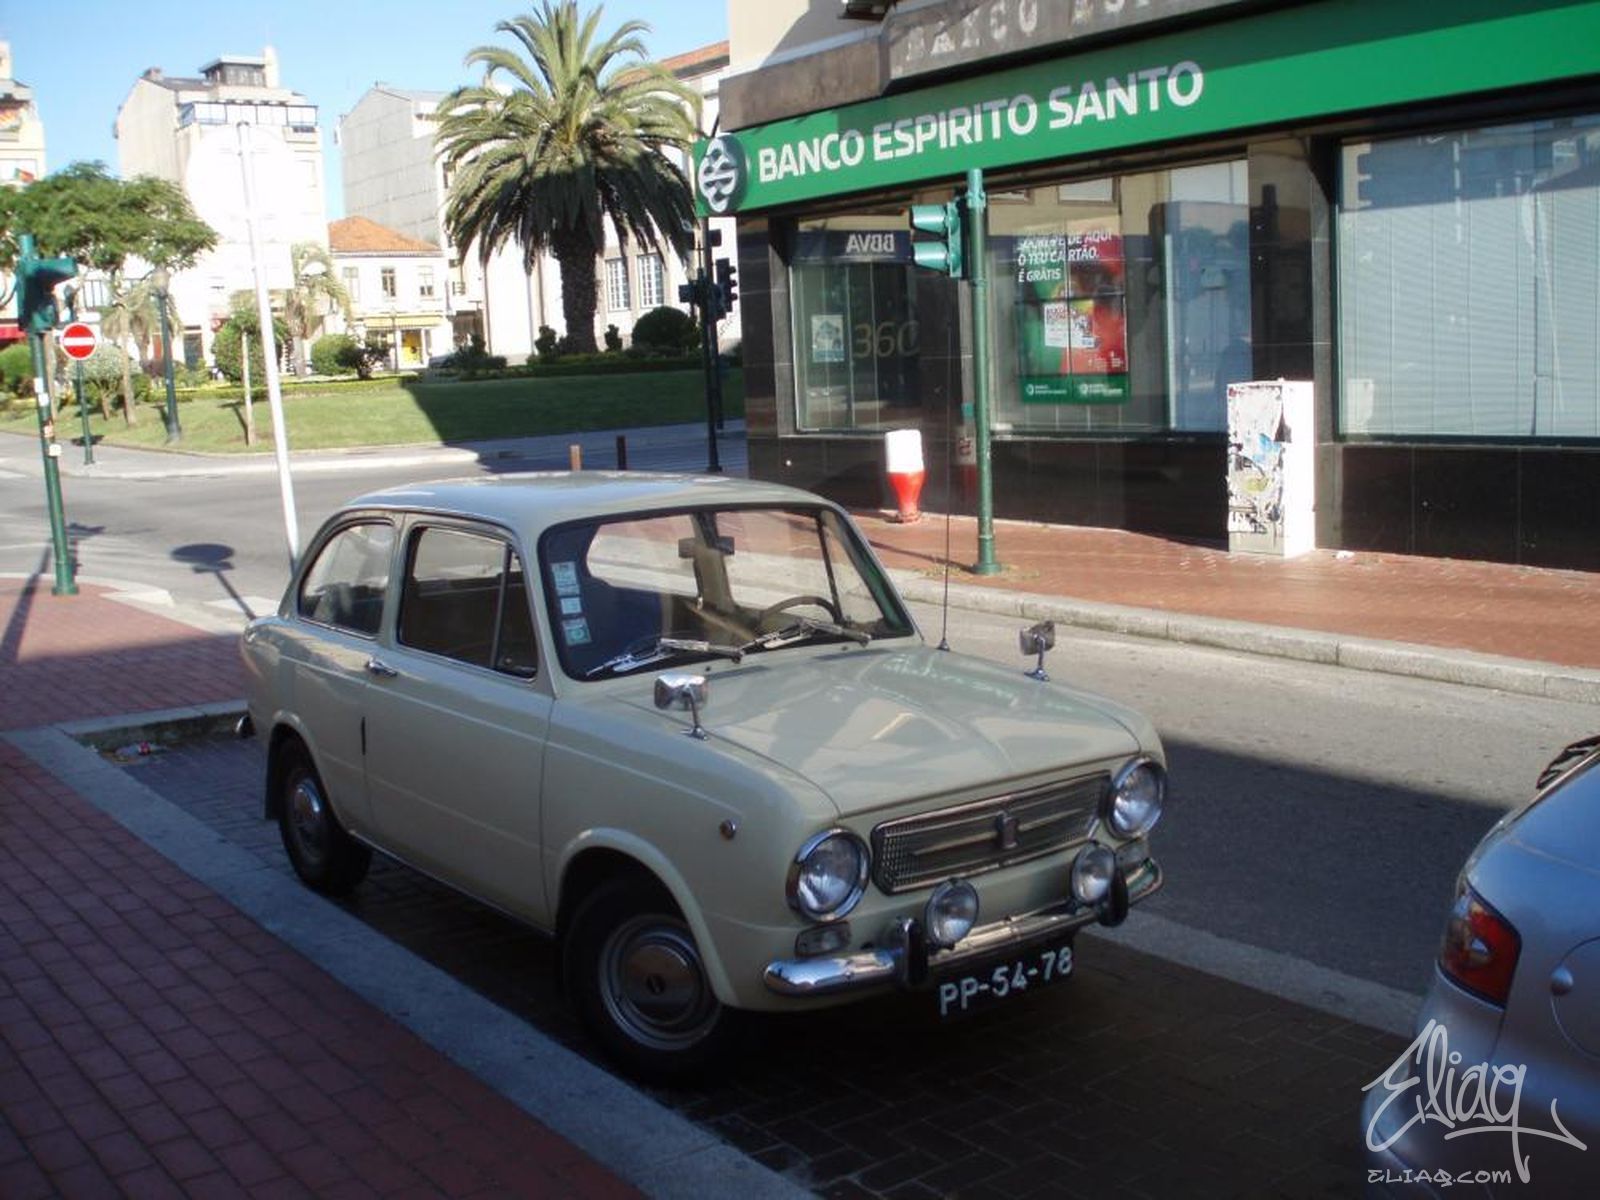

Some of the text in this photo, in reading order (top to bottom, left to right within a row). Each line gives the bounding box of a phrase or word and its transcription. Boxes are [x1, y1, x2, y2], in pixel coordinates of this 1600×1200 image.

[758, 60, 1205, 183] BANCO ESPIRITO SANTO
[1084, 229, 1112, 243] AQUI
[1017, 253, 1026, 267] O
[939, 946, 1073, 1016] PP-54-78
